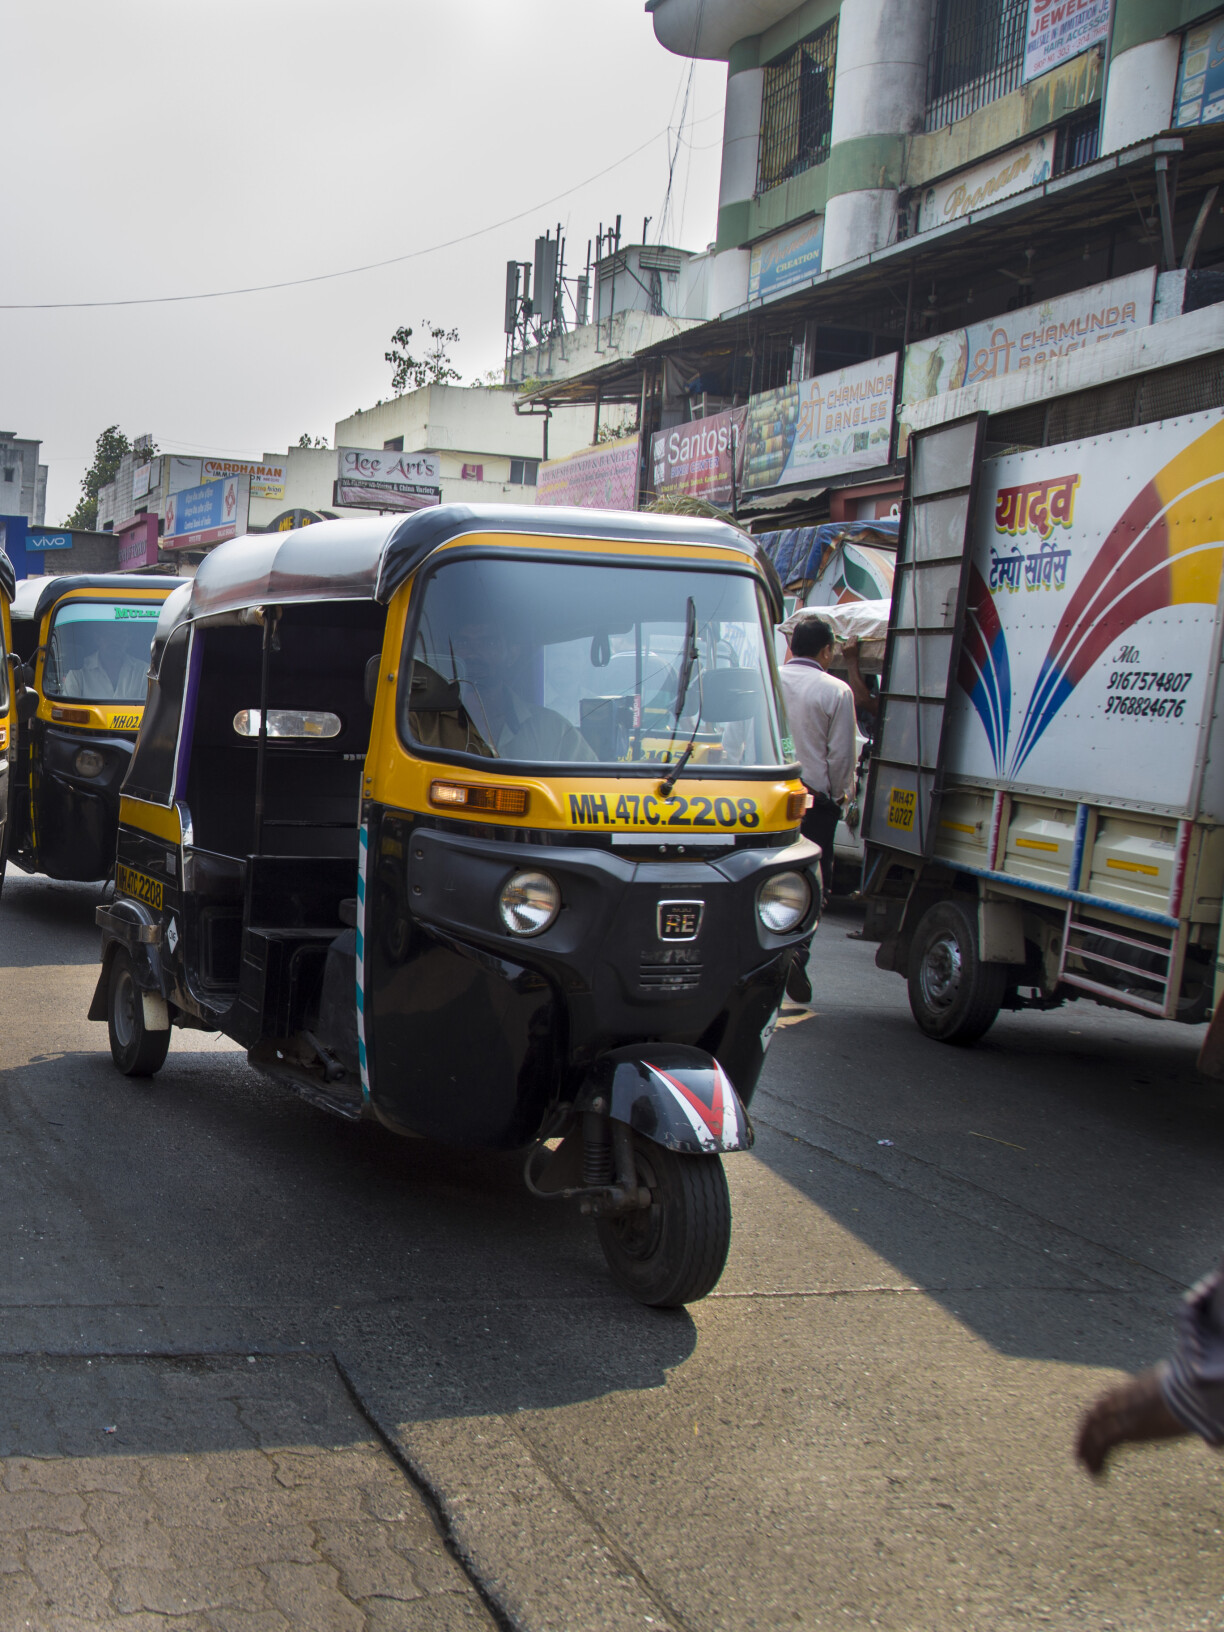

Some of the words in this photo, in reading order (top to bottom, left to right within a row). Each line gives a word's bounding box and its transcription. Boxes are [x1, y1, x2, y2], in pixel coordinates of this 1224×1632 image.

[1031, 0, 1099, 37] JEWEL
[775, 249, 820, 274] CREATION
[1019, 302, 1137, 350] CHAMUNDA
[826, 373, 894, 408] CHAMUNDA
[796, 381, 826, 443] श्री
[825, 400, 888, 433] BANGLES
[668, 424, 739, 464] Santosh
[204, 461, 283, 477] VARDHAMAN
[345, 452, 382, 478] Lee
[386, 456, 435, 480] Art's
[690, 456, 719, 473] CENTER
[995, 474, 1081, 539] यादव
[32, 536, 65, 547] vivo
[989, 547, 1025, 595] टेम्पो
[1112, 645, 1140, 664] Mo.
[1107, 672, 1192, 692] 9167574807
[1105, 698, 1186, 718] 9768824676
[569, 794, 759, 828] MH.47.C.2208
[665, 914, 696, 933] RE
